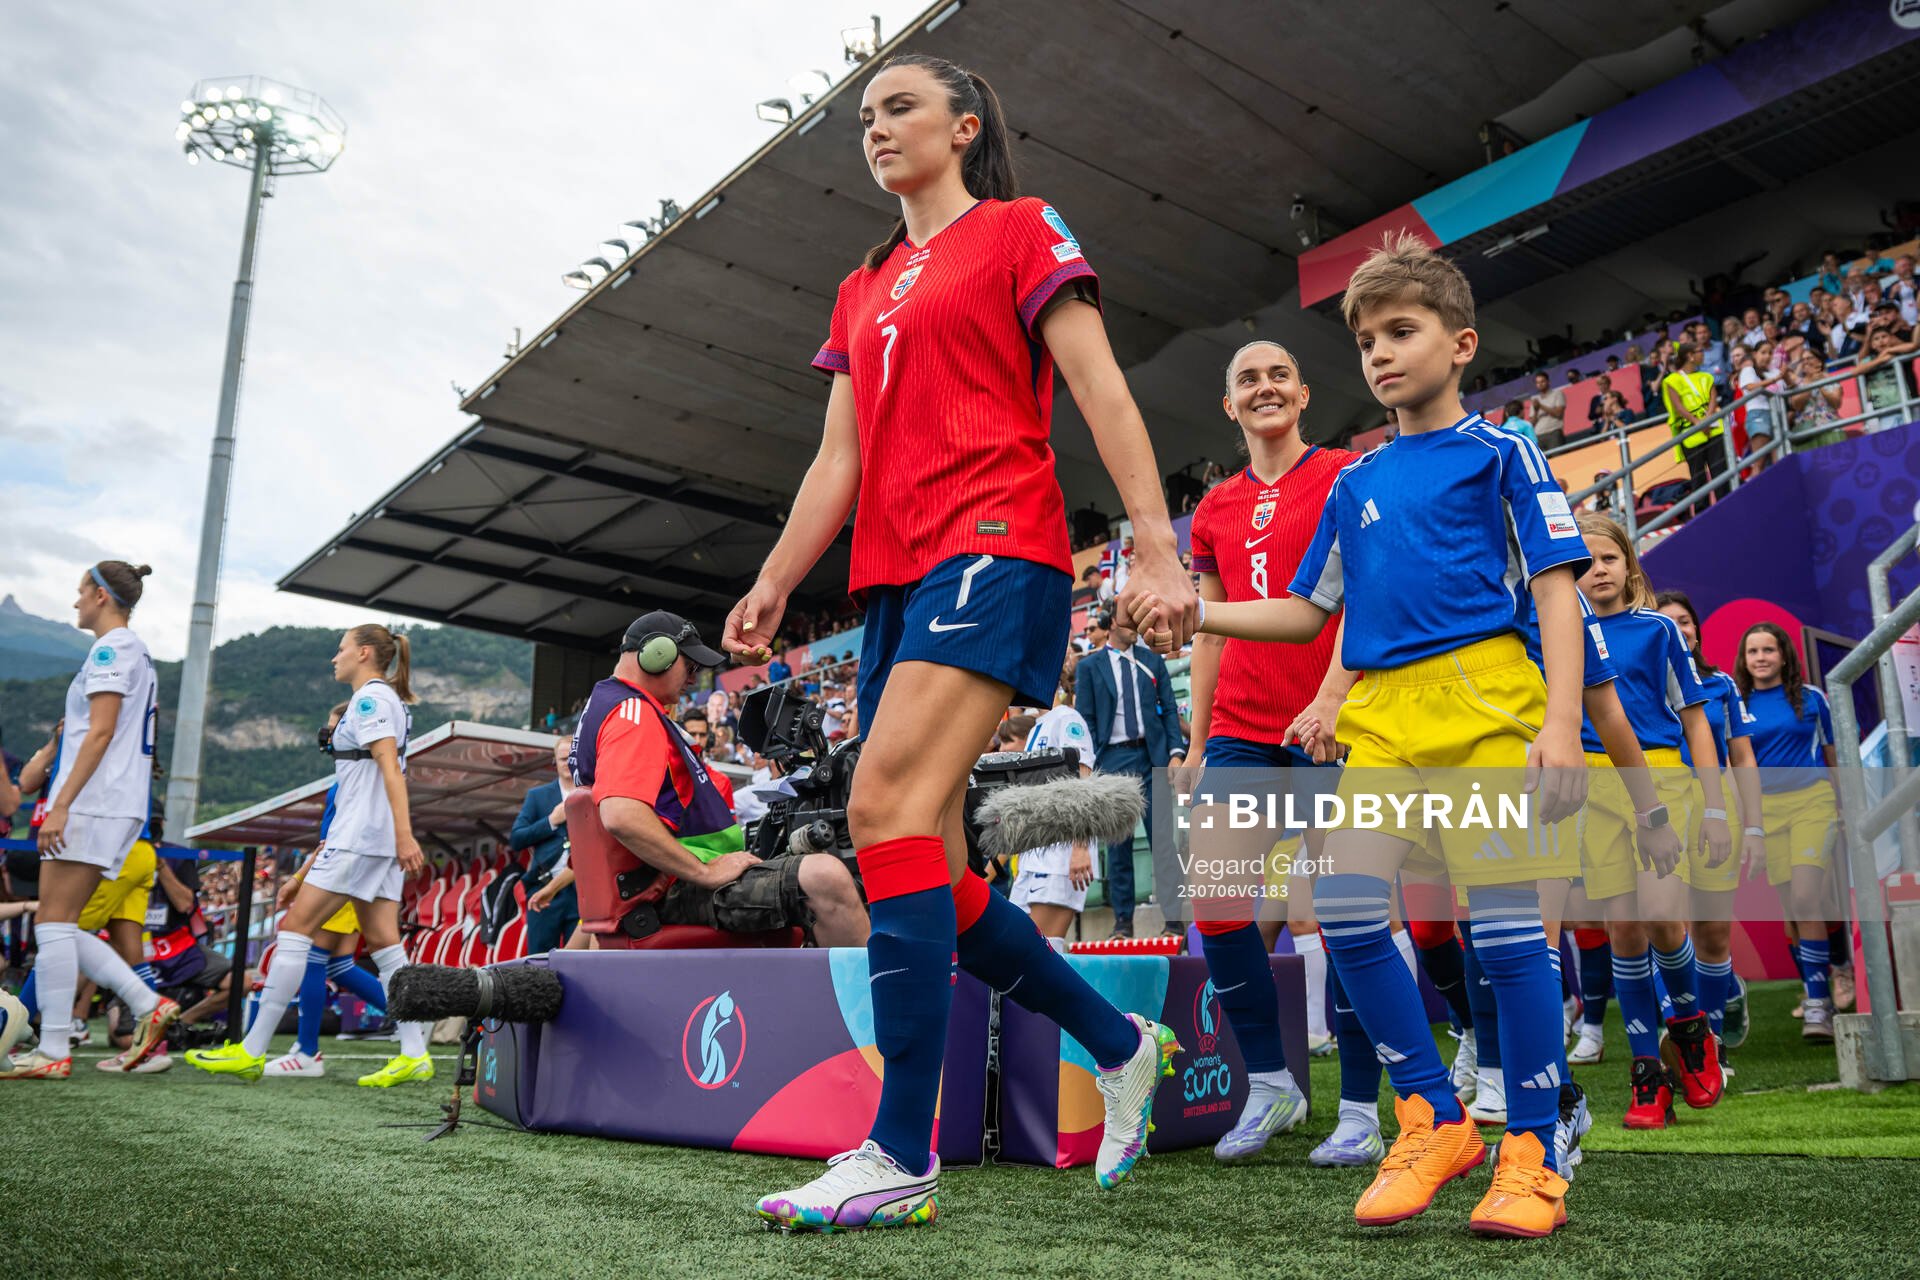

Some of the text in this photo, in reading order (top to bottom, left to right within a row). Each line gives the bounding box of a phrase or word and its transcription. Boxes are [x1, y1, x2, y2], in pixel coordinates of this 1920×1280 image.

[881, 324, 898, 392] 7
[955, 554, 995, 611] 7
[1250, 552, 1268, 600] 8
